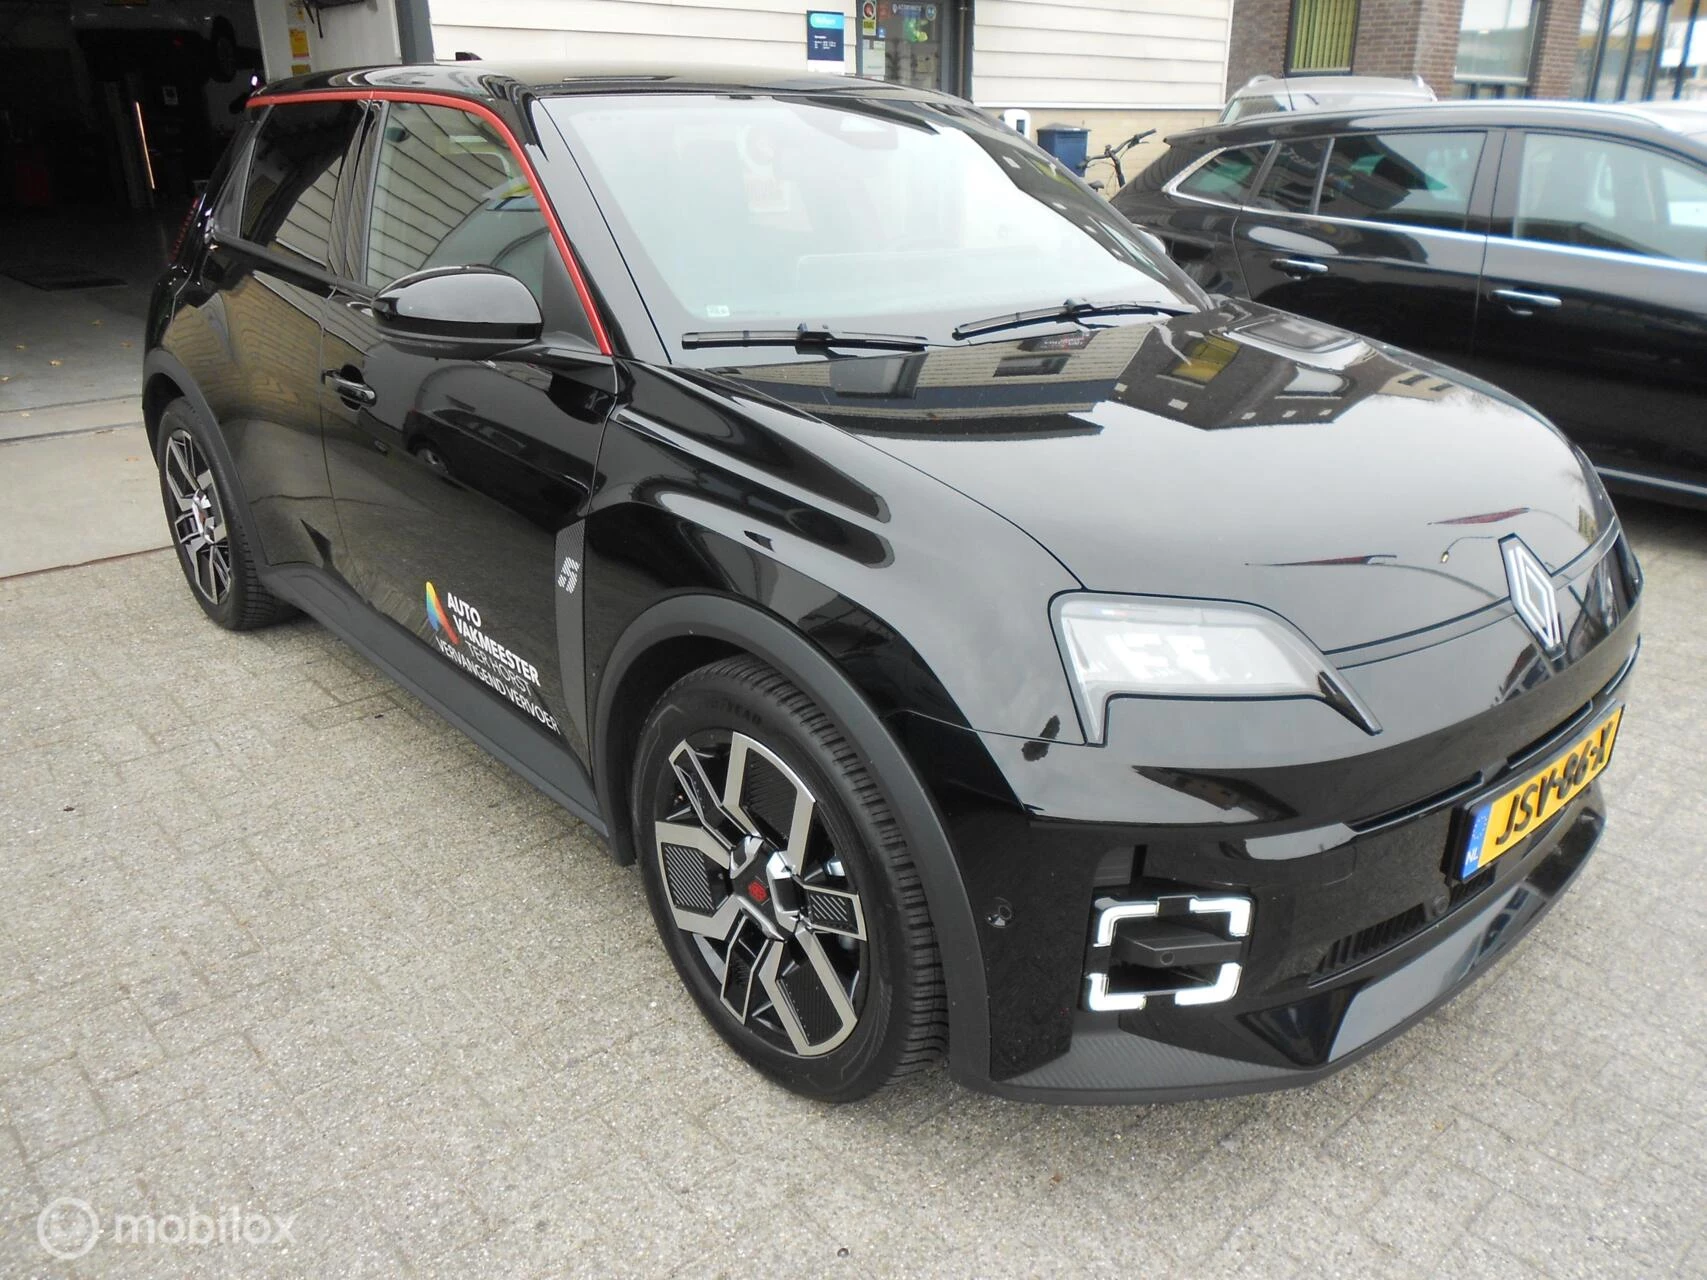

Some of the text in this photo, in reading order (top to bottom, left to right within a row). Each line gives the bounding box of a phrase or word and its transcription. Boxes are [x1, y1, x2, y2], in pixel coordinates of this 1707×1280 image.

[447, 591, 482, 628] AUTO
[452, 614, 541, 687] VAKMEESTER
[464, 640, 532, 696] TER HORST
[435, 635, 562, 736] VERVANGEND VERVOER
[1464, 848, 1479, 865] NL
